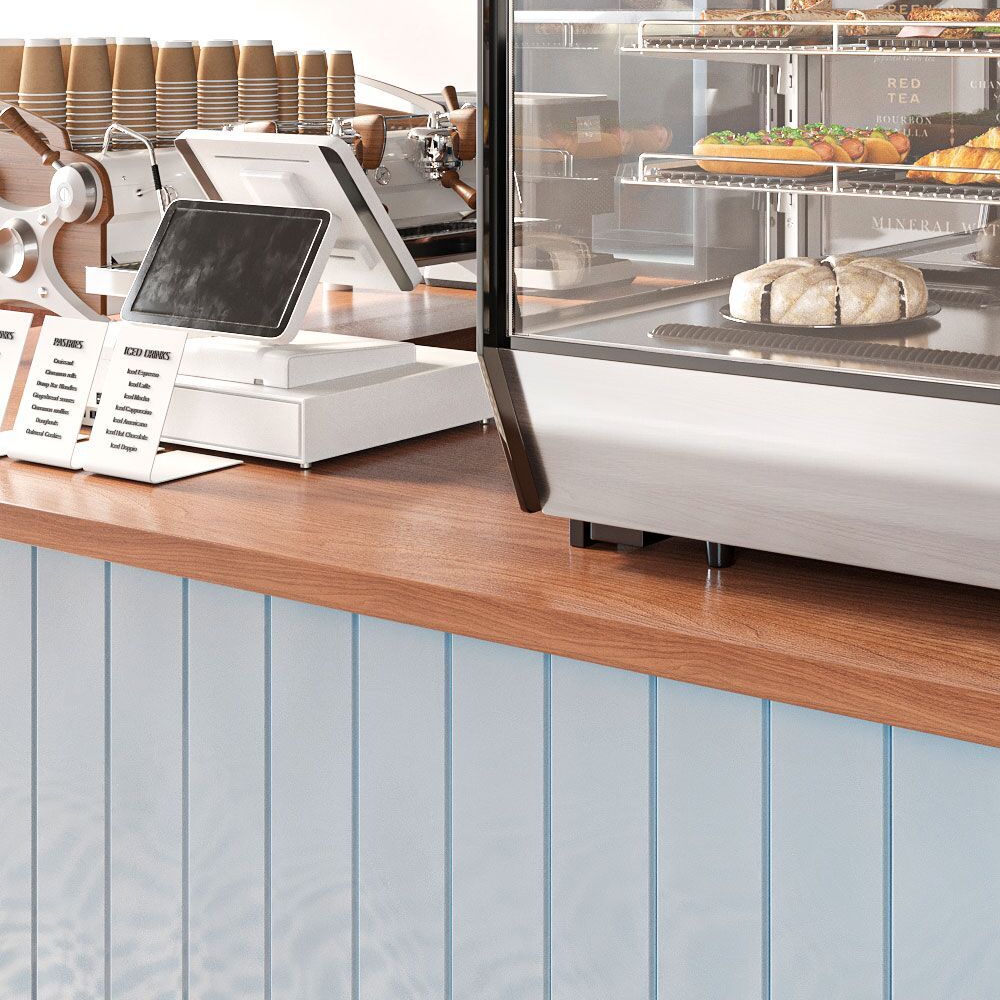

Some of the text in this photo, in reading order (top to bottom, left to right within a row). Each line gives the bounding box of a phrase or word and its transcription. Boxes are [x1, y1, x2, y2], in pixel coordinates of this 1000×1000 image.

[887, 77, 922, 89] RED
[887, 92, 921, 104] TEA
[875, 114, 933, 125] BOURBON
[872, 215, 954, 233] MINERAL
[123, 346, 171, 361] ICED DRINKS
